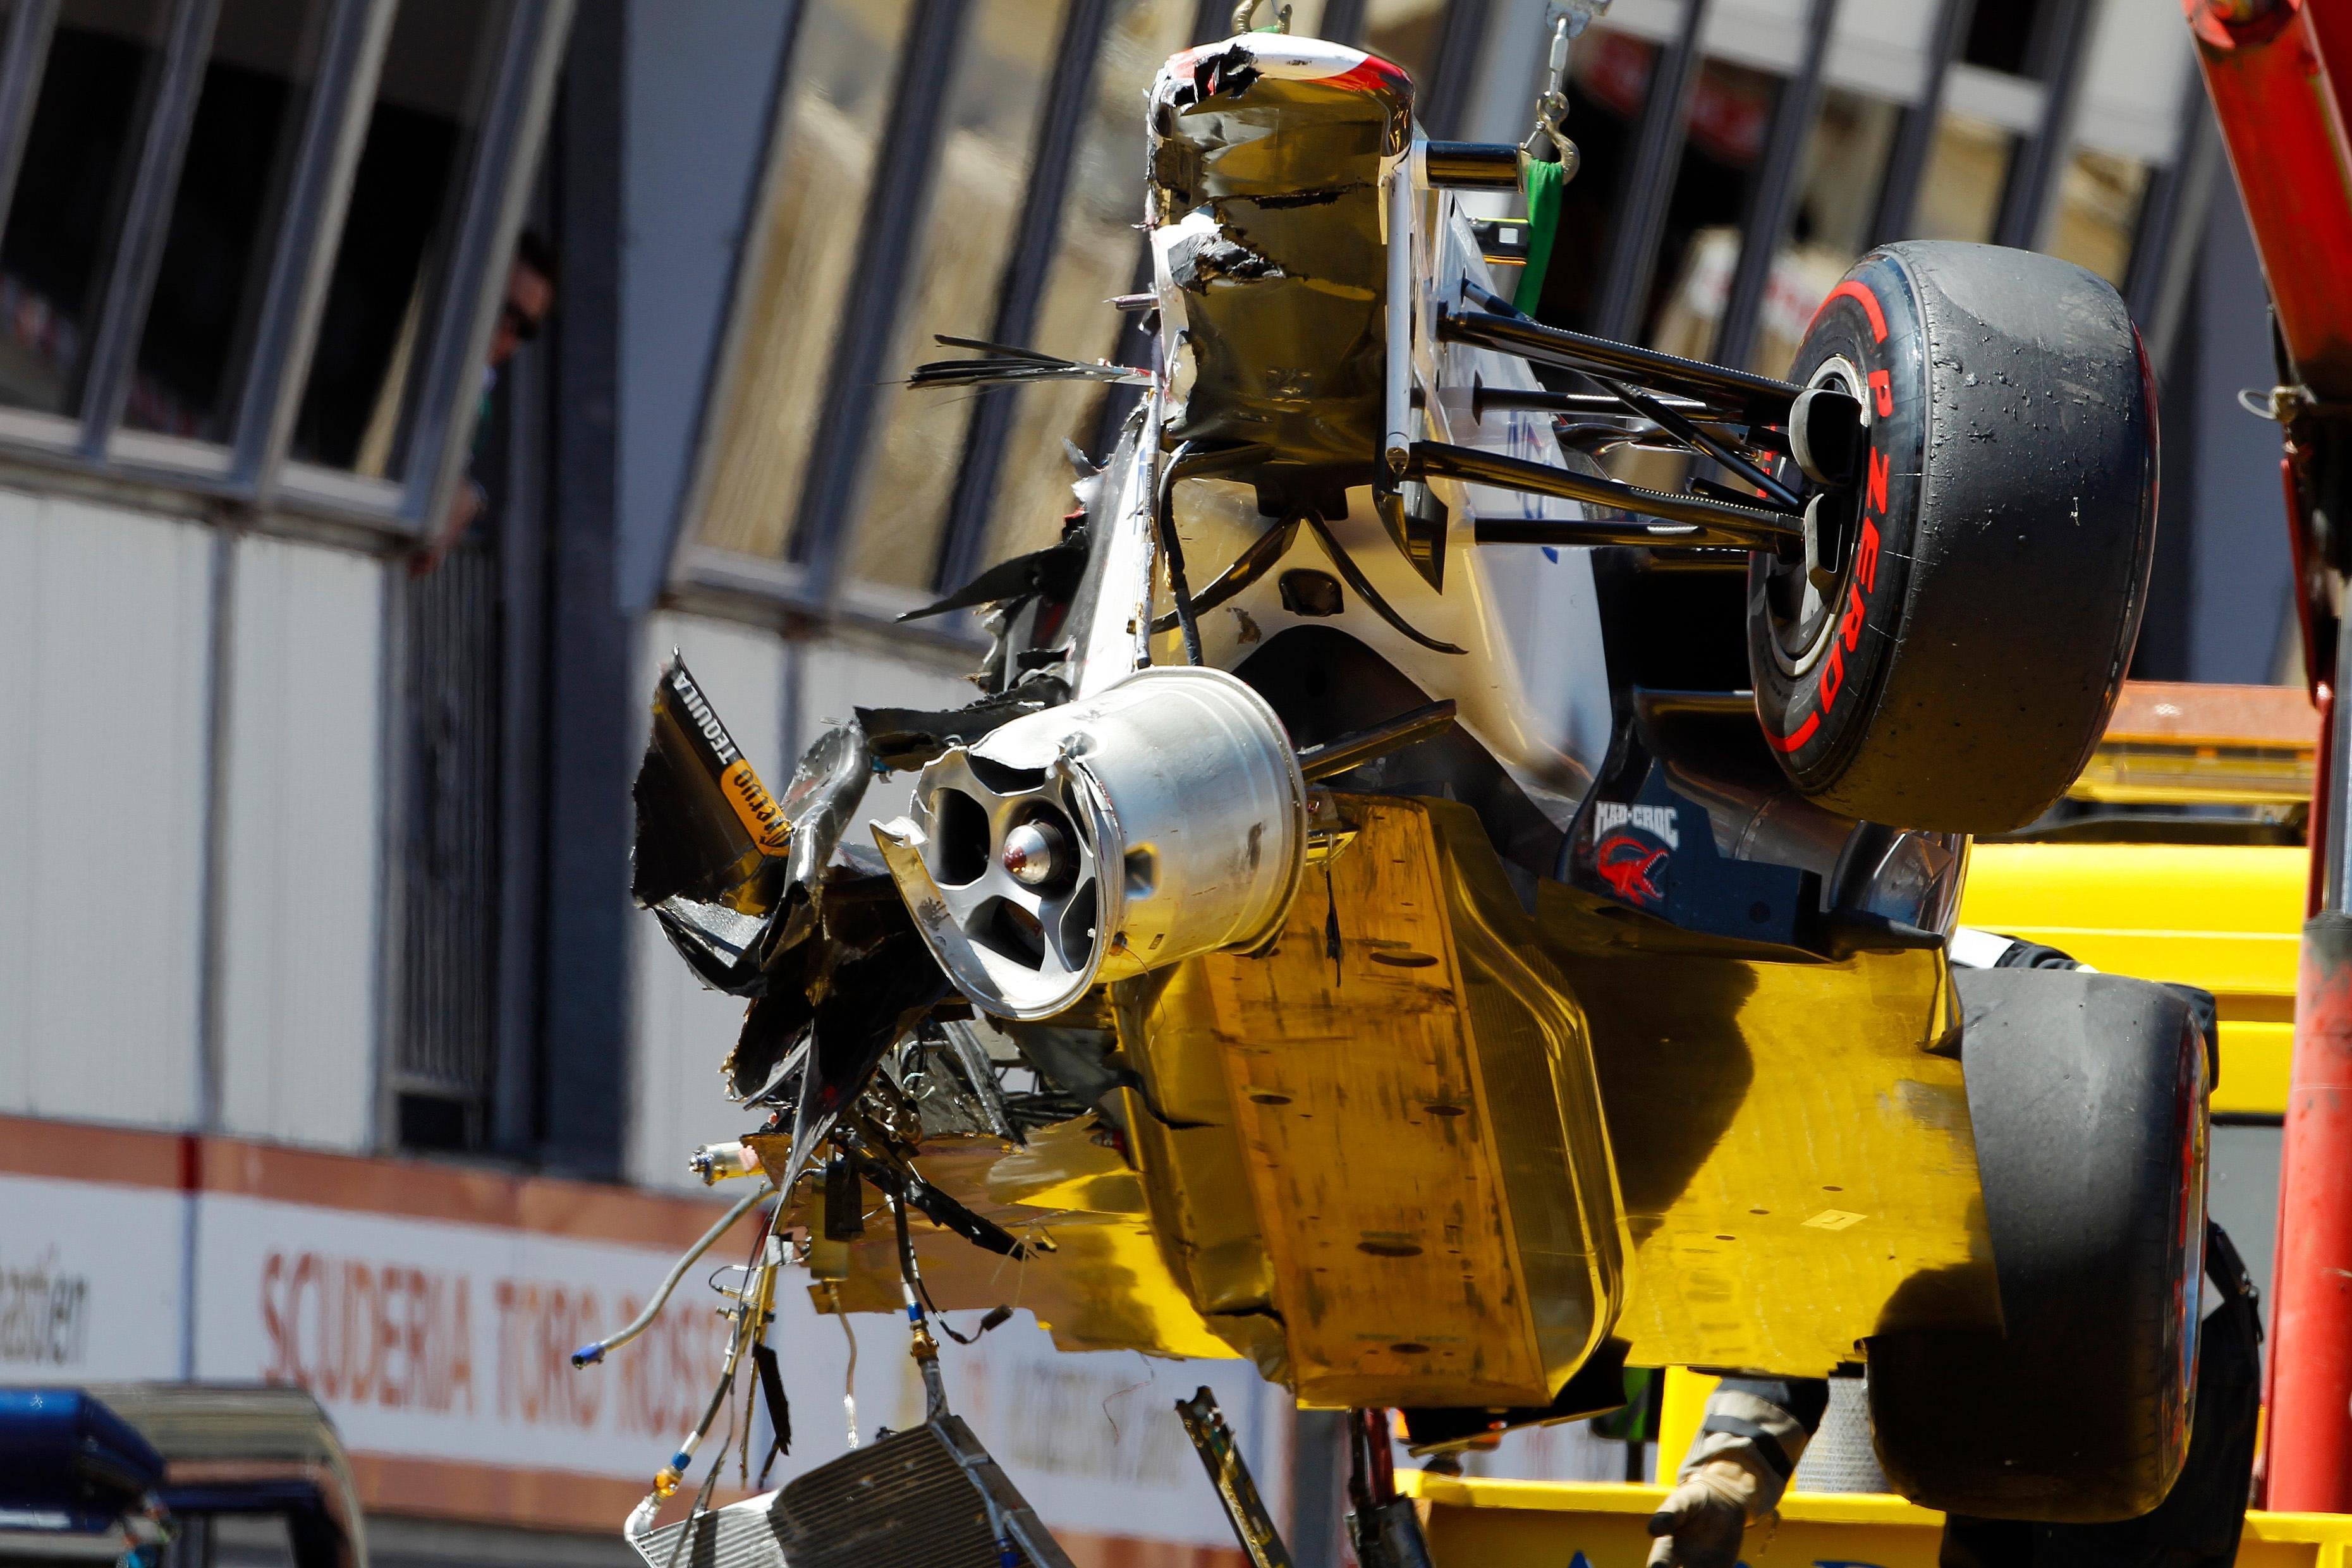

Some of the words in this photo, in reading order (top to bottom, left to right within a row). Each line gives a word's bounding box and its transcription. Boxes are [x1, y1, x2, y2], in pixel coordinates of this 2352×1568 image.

[1868, 370, 1892, 418] P
[1820, 446, 1891, 714] ZERO
[672, 670, 738, 765] TEQUILA
[1592, 800, 1680, 852] MAD-CROC
[260, 1249, 473, 1414] SCUDERIA
[493, 1277, 604, 1430] TORO
